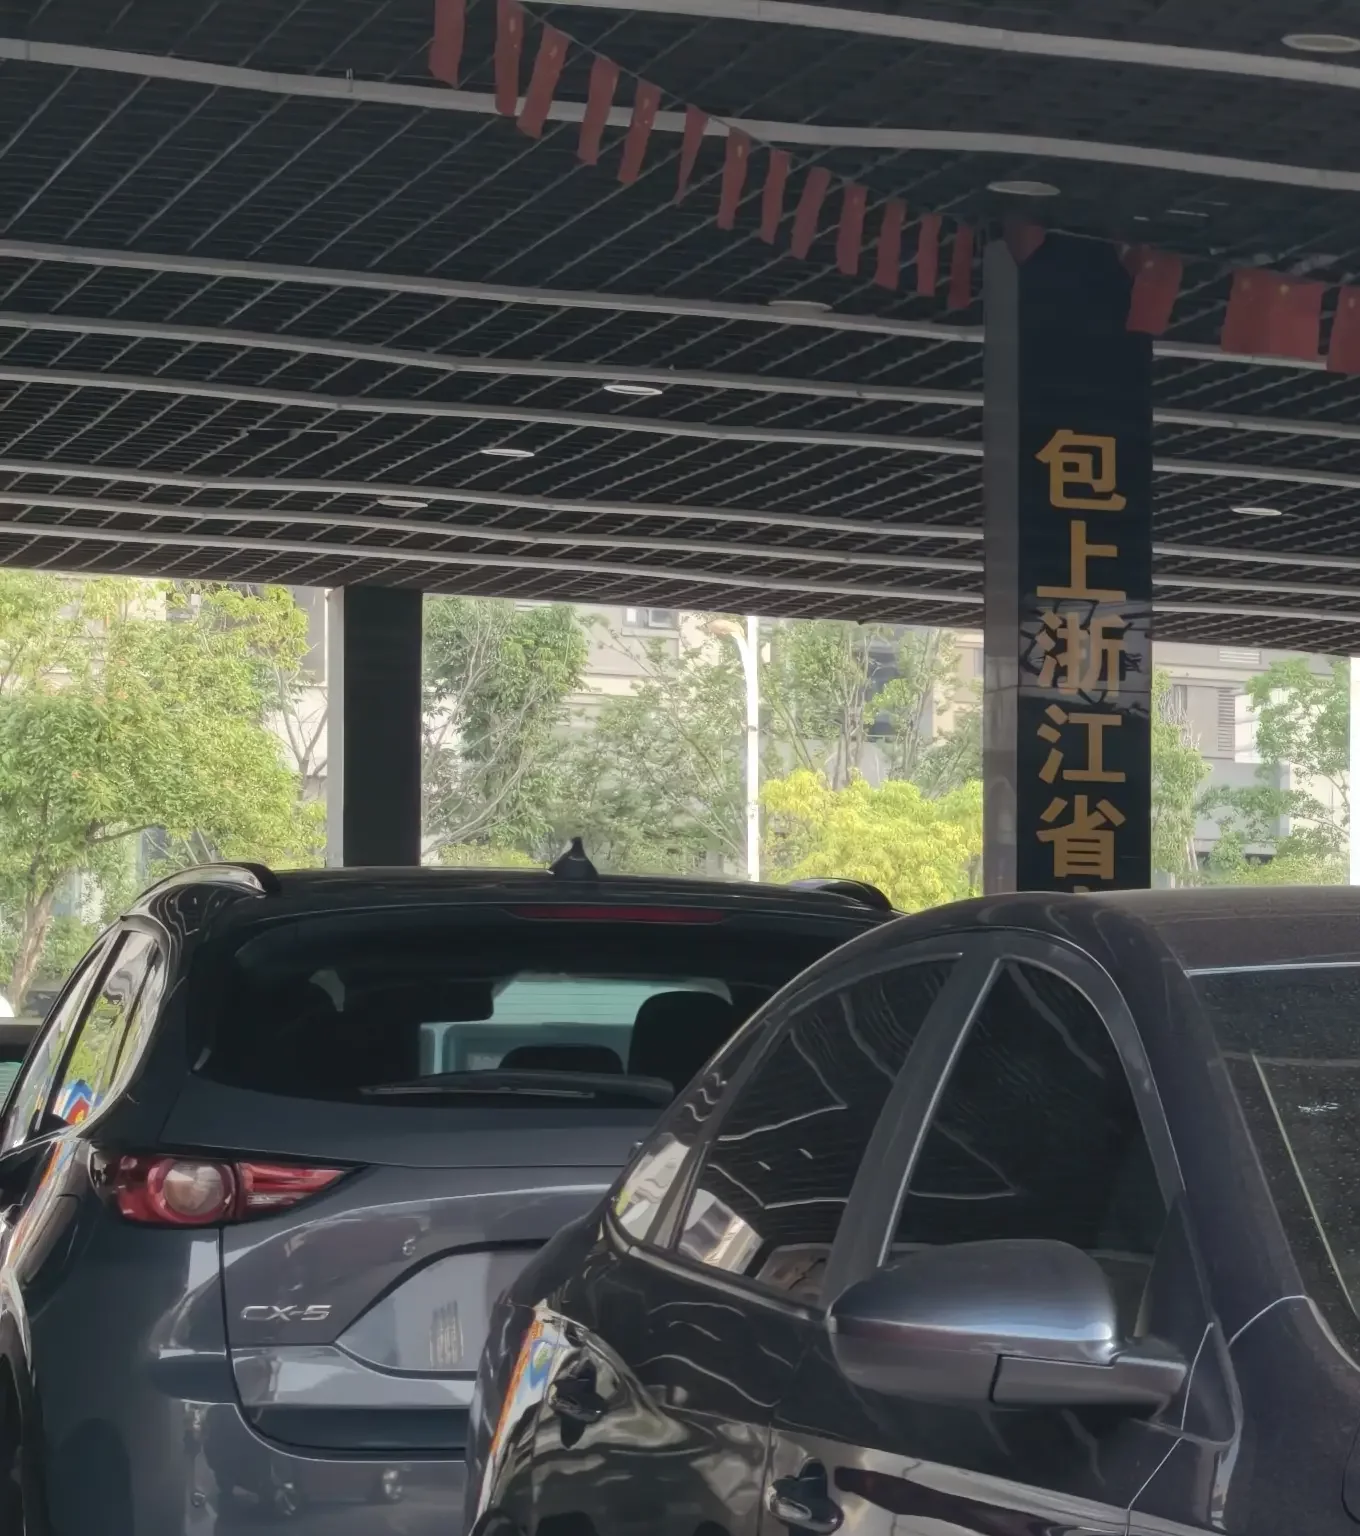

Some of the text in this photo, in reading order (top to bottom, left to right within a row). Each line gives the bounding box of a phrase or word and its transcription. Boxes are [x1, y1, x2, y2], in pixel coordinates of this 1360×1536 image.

[1035, 429, 1127, 893] 包上浙江省
[240, 1304, 332, 1321] CX-5
